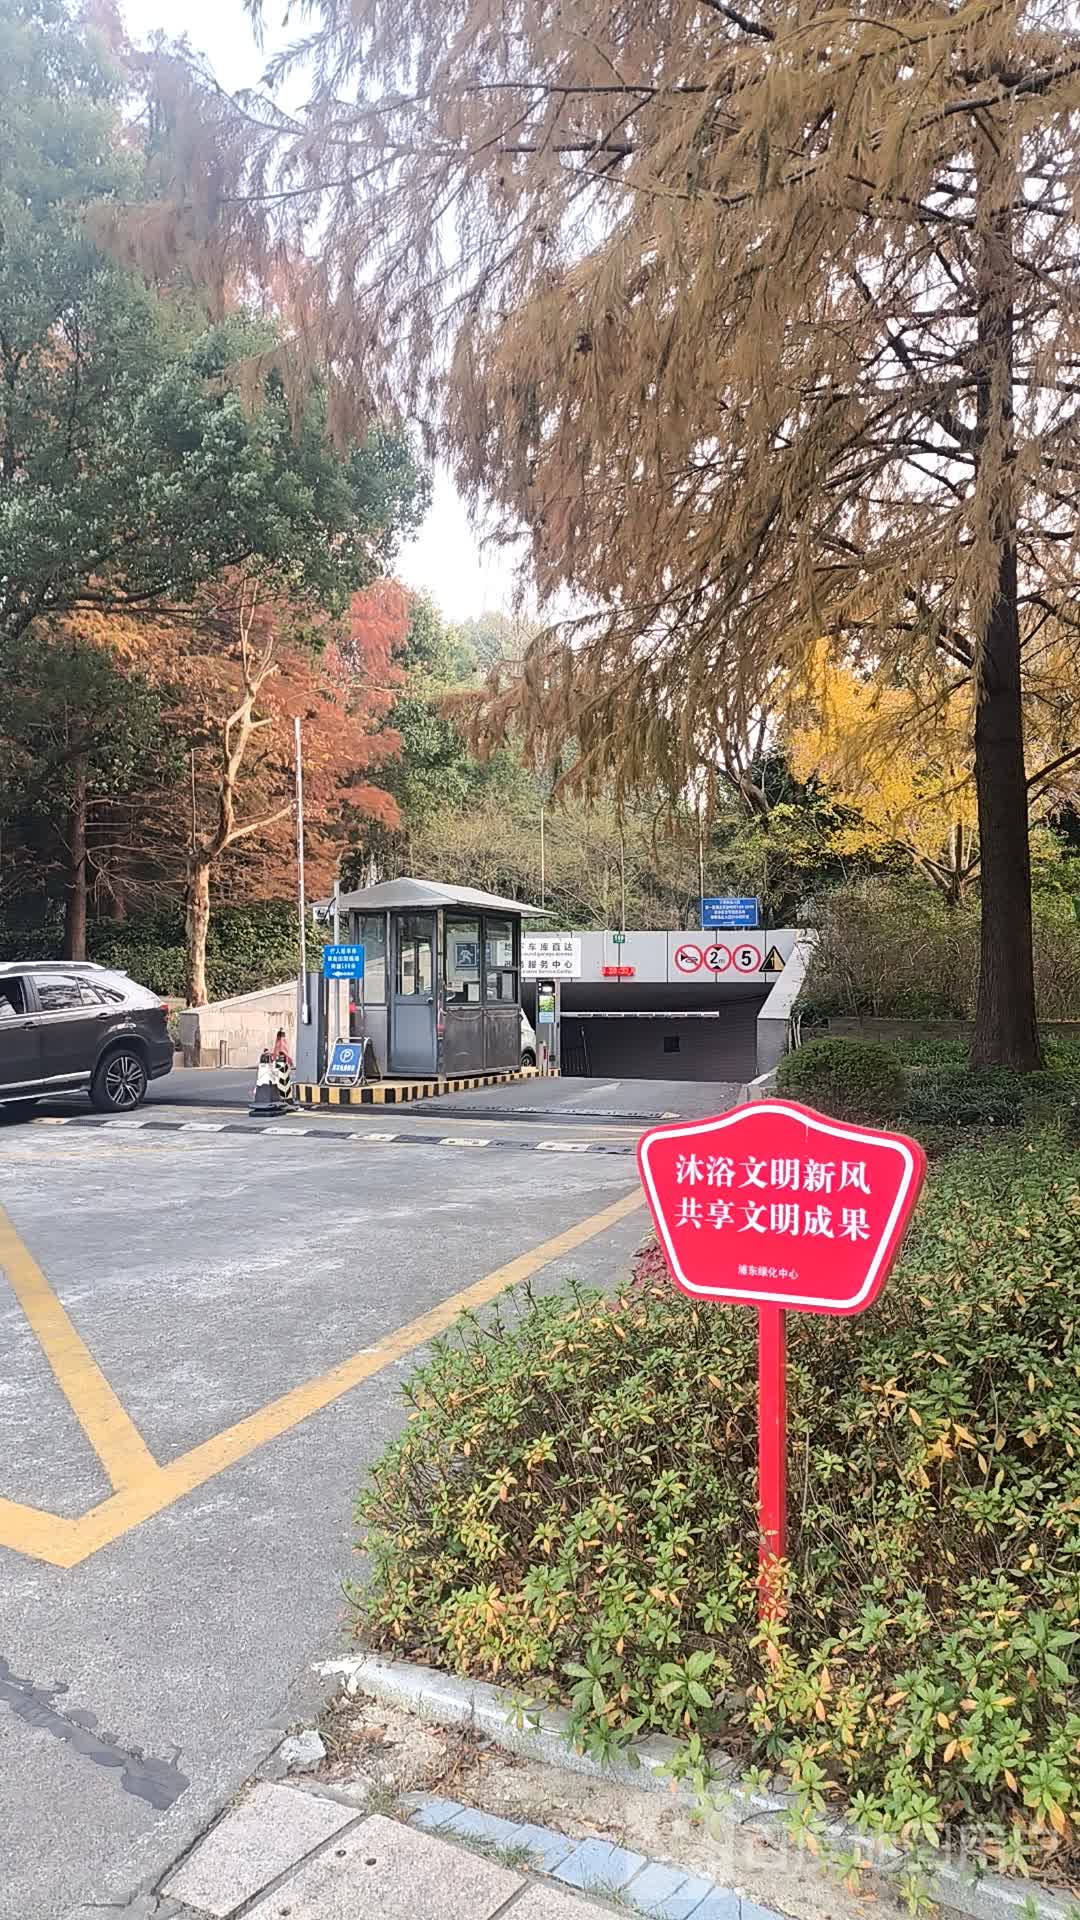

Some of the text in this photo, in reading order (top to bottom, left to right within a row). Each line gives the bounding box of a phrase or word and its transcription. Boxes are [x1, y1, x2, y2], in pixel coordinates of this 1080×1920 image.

[741, 950, 752, 967] 5
[675, 1153, 872, 1195] 沐浴文明新风
[674, 1197, 872, 1242] 共享文明成果
[738, 1264, 799, 1280] 浦东绿化中心
